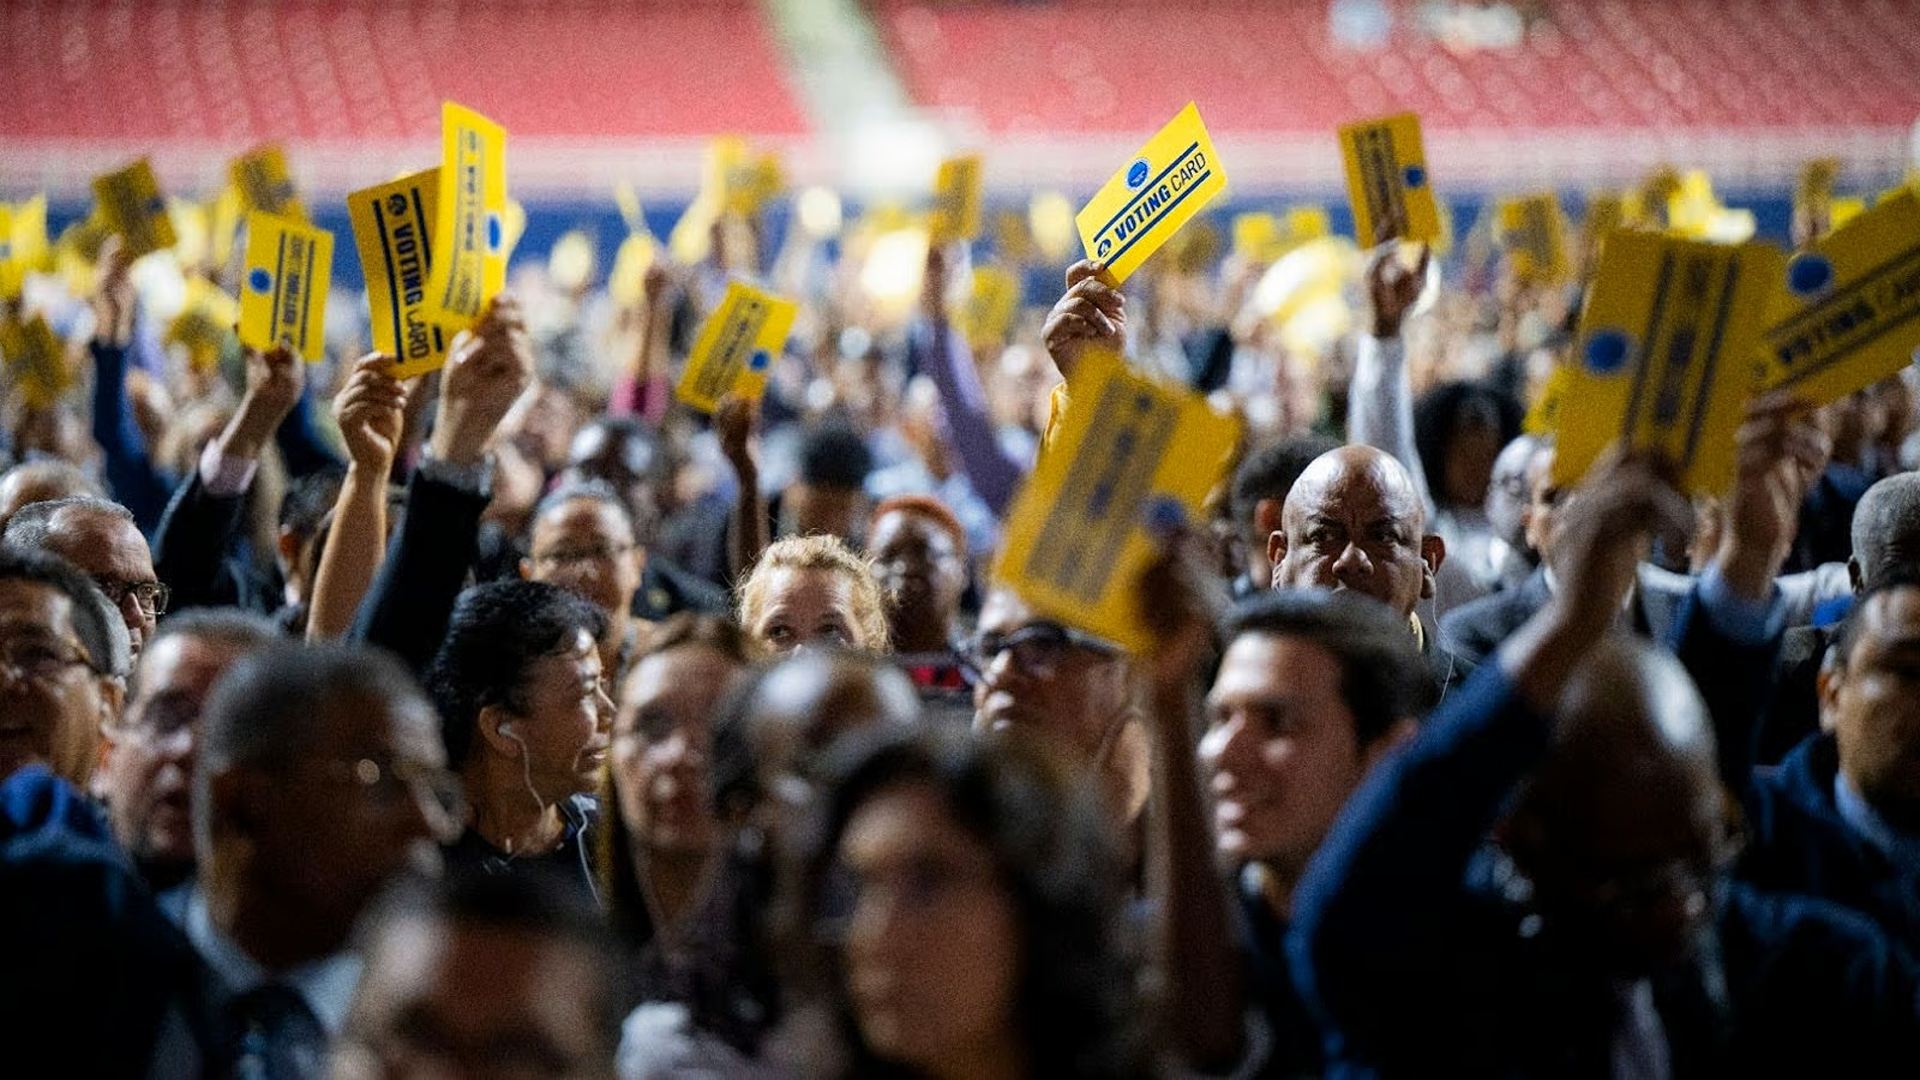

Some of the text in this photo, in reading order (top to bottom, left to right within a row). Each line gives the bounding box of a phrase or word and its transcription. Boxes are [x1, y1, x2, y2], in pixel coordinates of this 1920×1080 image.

[1114, 152, 1206, 241] VOTING CARD
[394, 222, 424, 306] VOTING
